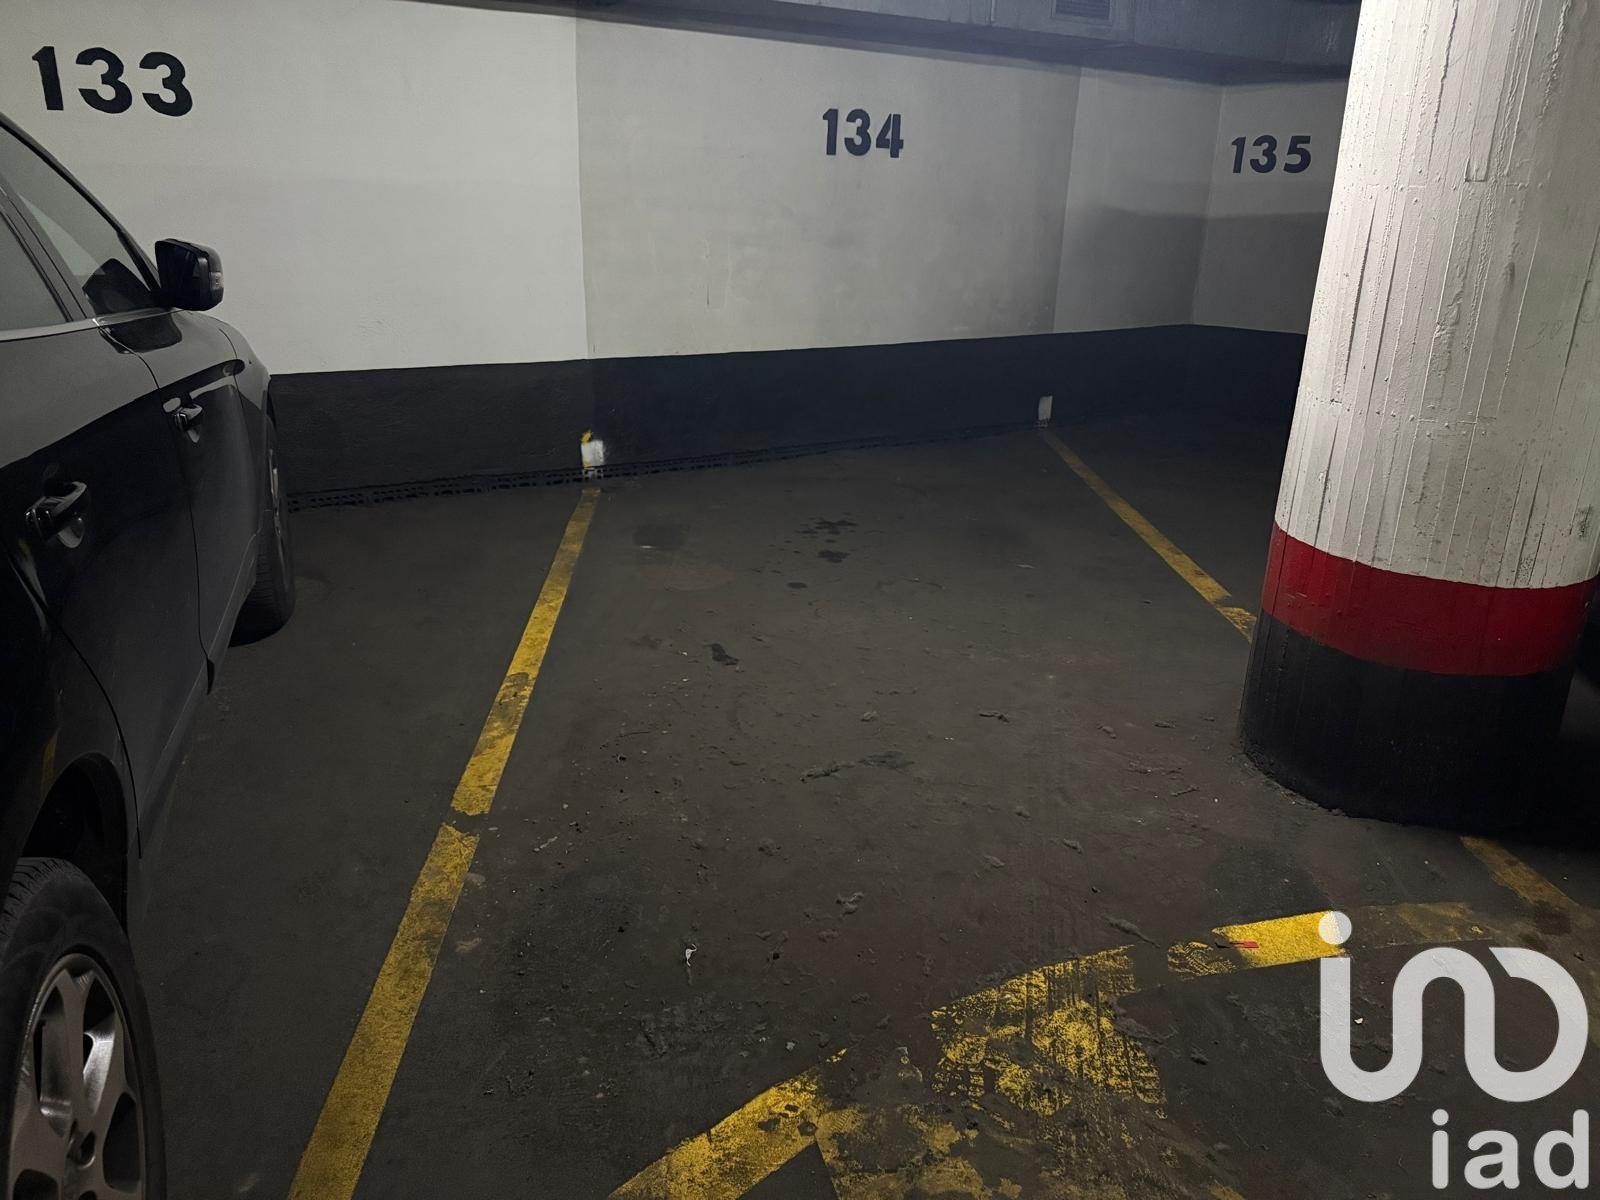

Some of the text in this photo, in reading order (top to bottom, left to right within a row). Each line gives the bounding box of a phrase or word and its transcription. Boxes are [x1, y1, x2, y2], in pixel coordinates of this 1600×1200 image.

[31, 45, 193, 117] 133
[822, 108, 904, 158] 134
[1231, 134, 1312, 174] 135
